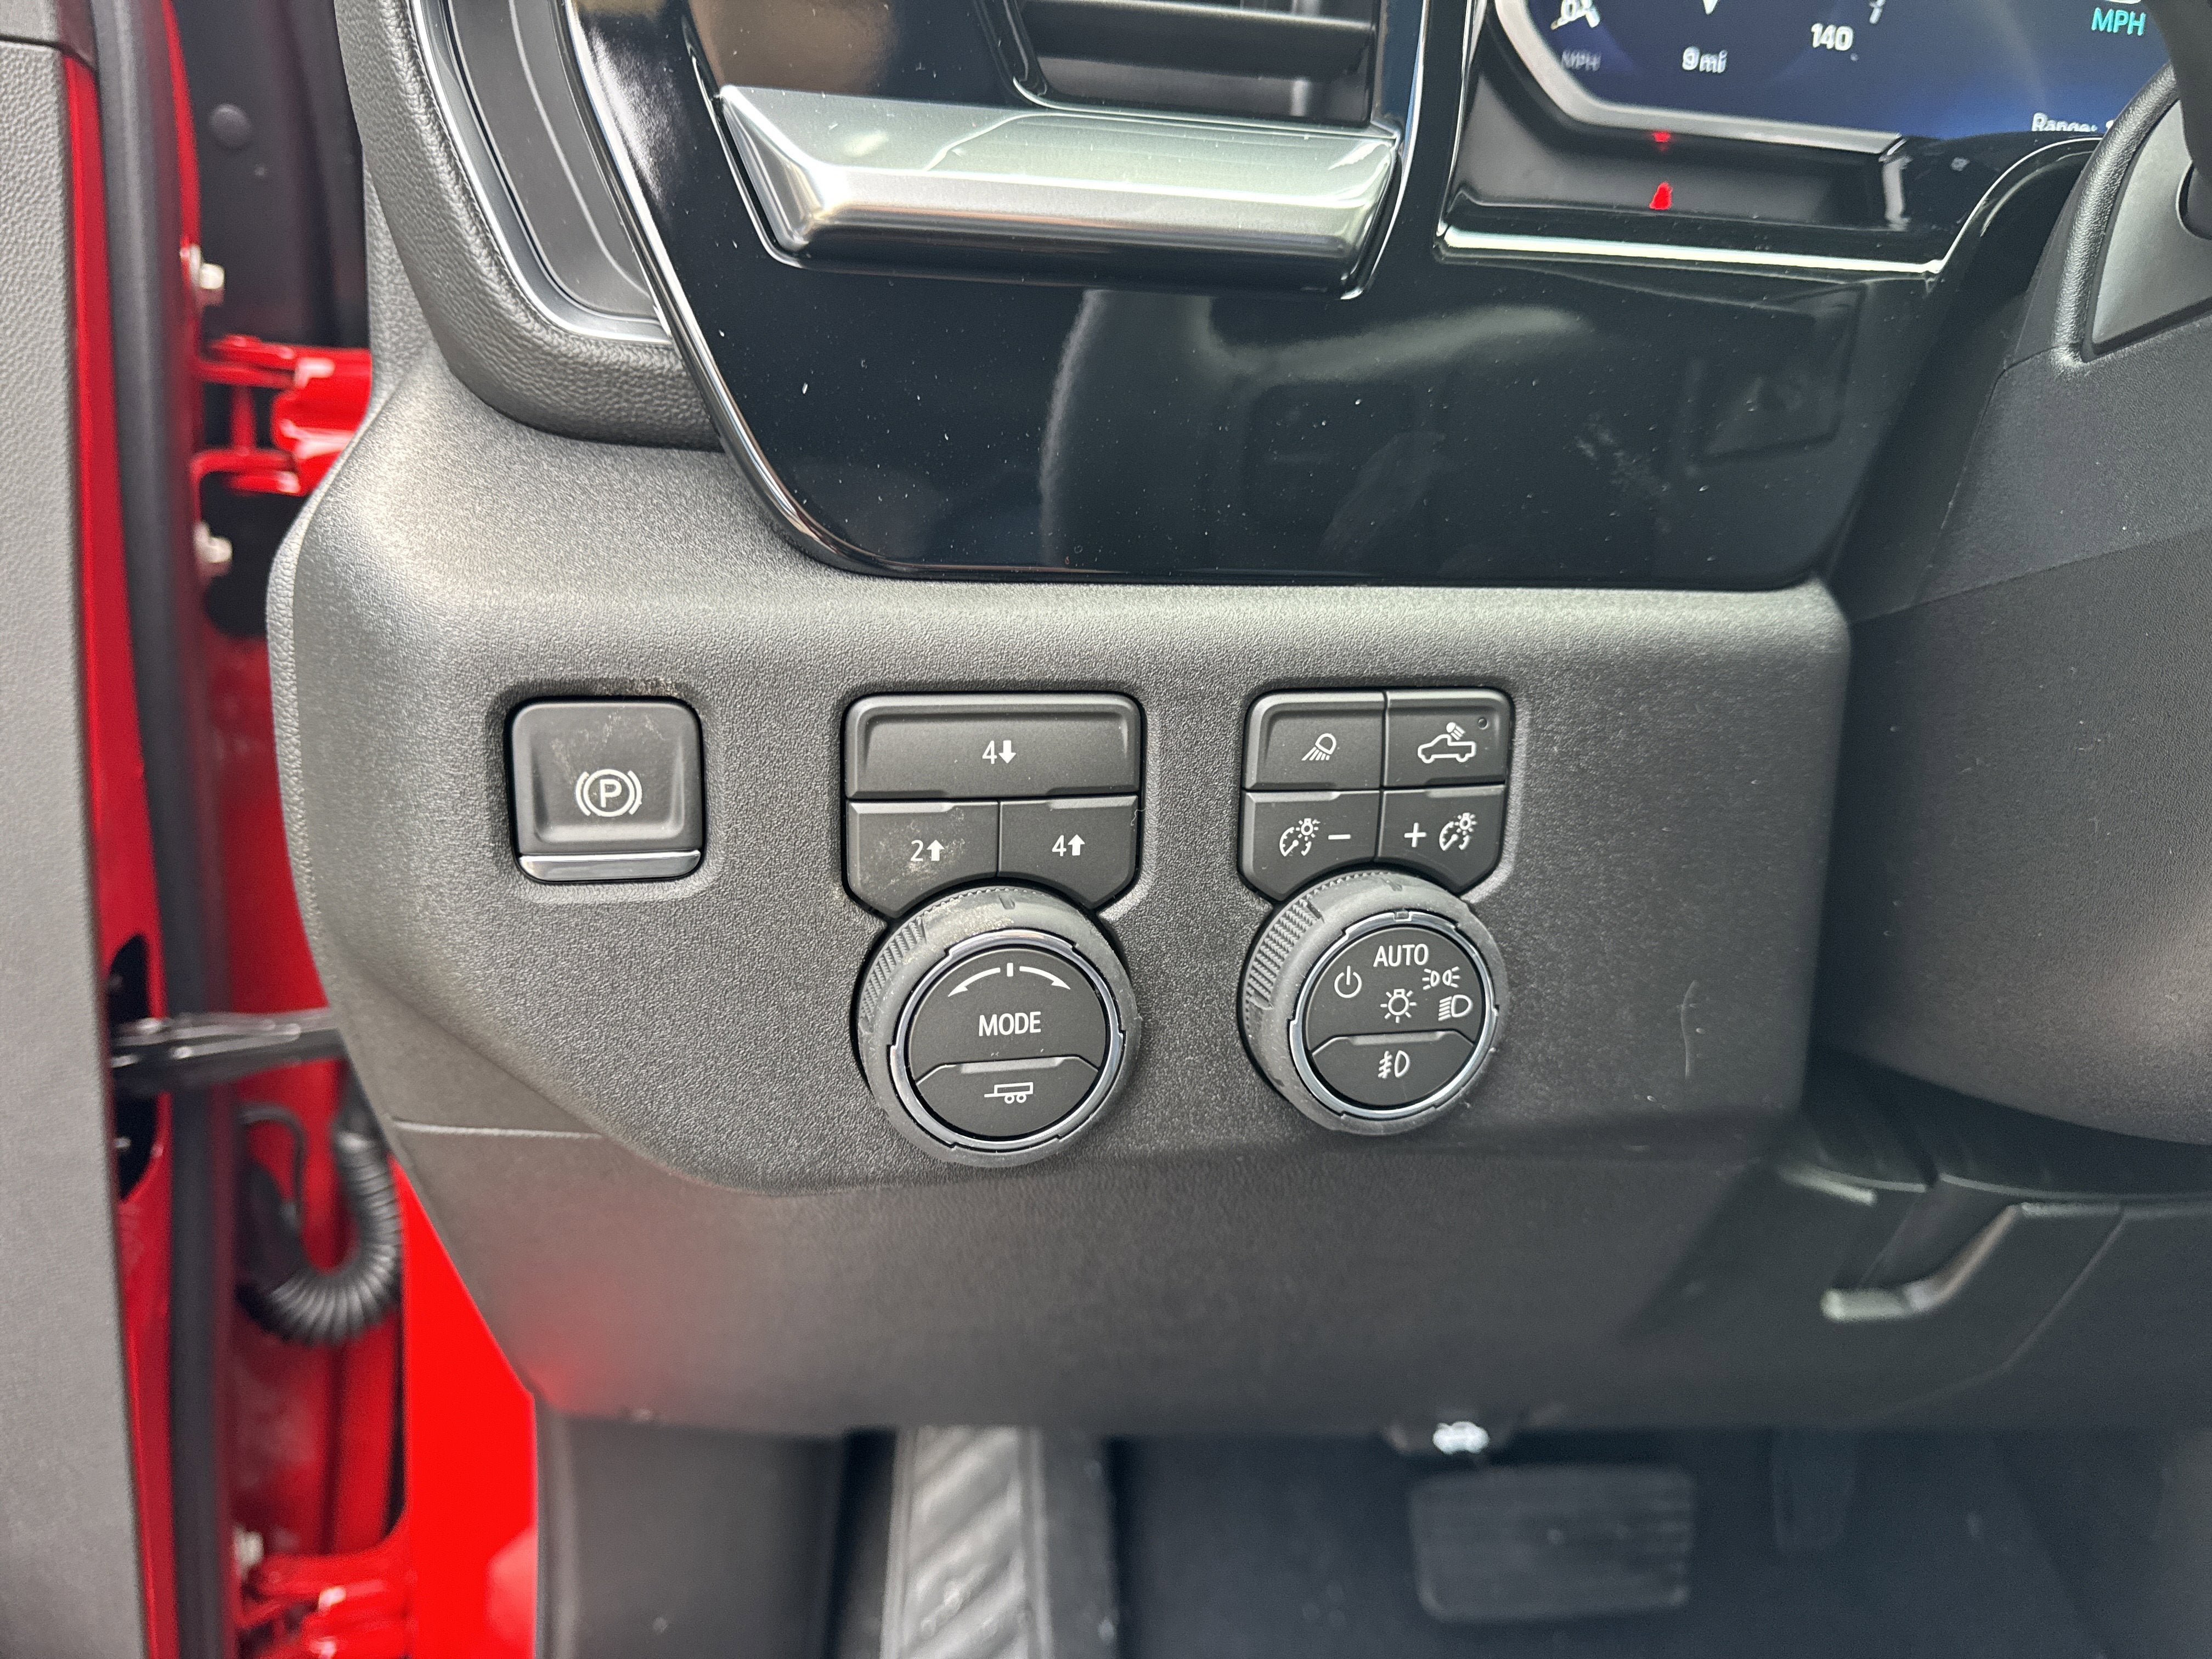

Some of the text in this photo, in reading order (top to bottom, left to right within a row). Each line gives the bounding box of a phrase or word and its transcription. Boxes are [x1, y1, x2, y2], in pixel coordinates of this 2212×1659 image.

[2091, 7, 2147, 36] MPH
[1811, 22, 1854, 51] 140
[982, 741, 997, 764] 4
[599, 778, 622, 808] P
[910, 839, 924, 862] 2
[1052, 834, 1067, 857] 4
[1373, 943, 1429, 967] AUTO
[978, 1011, 1041, 1037] MODE
